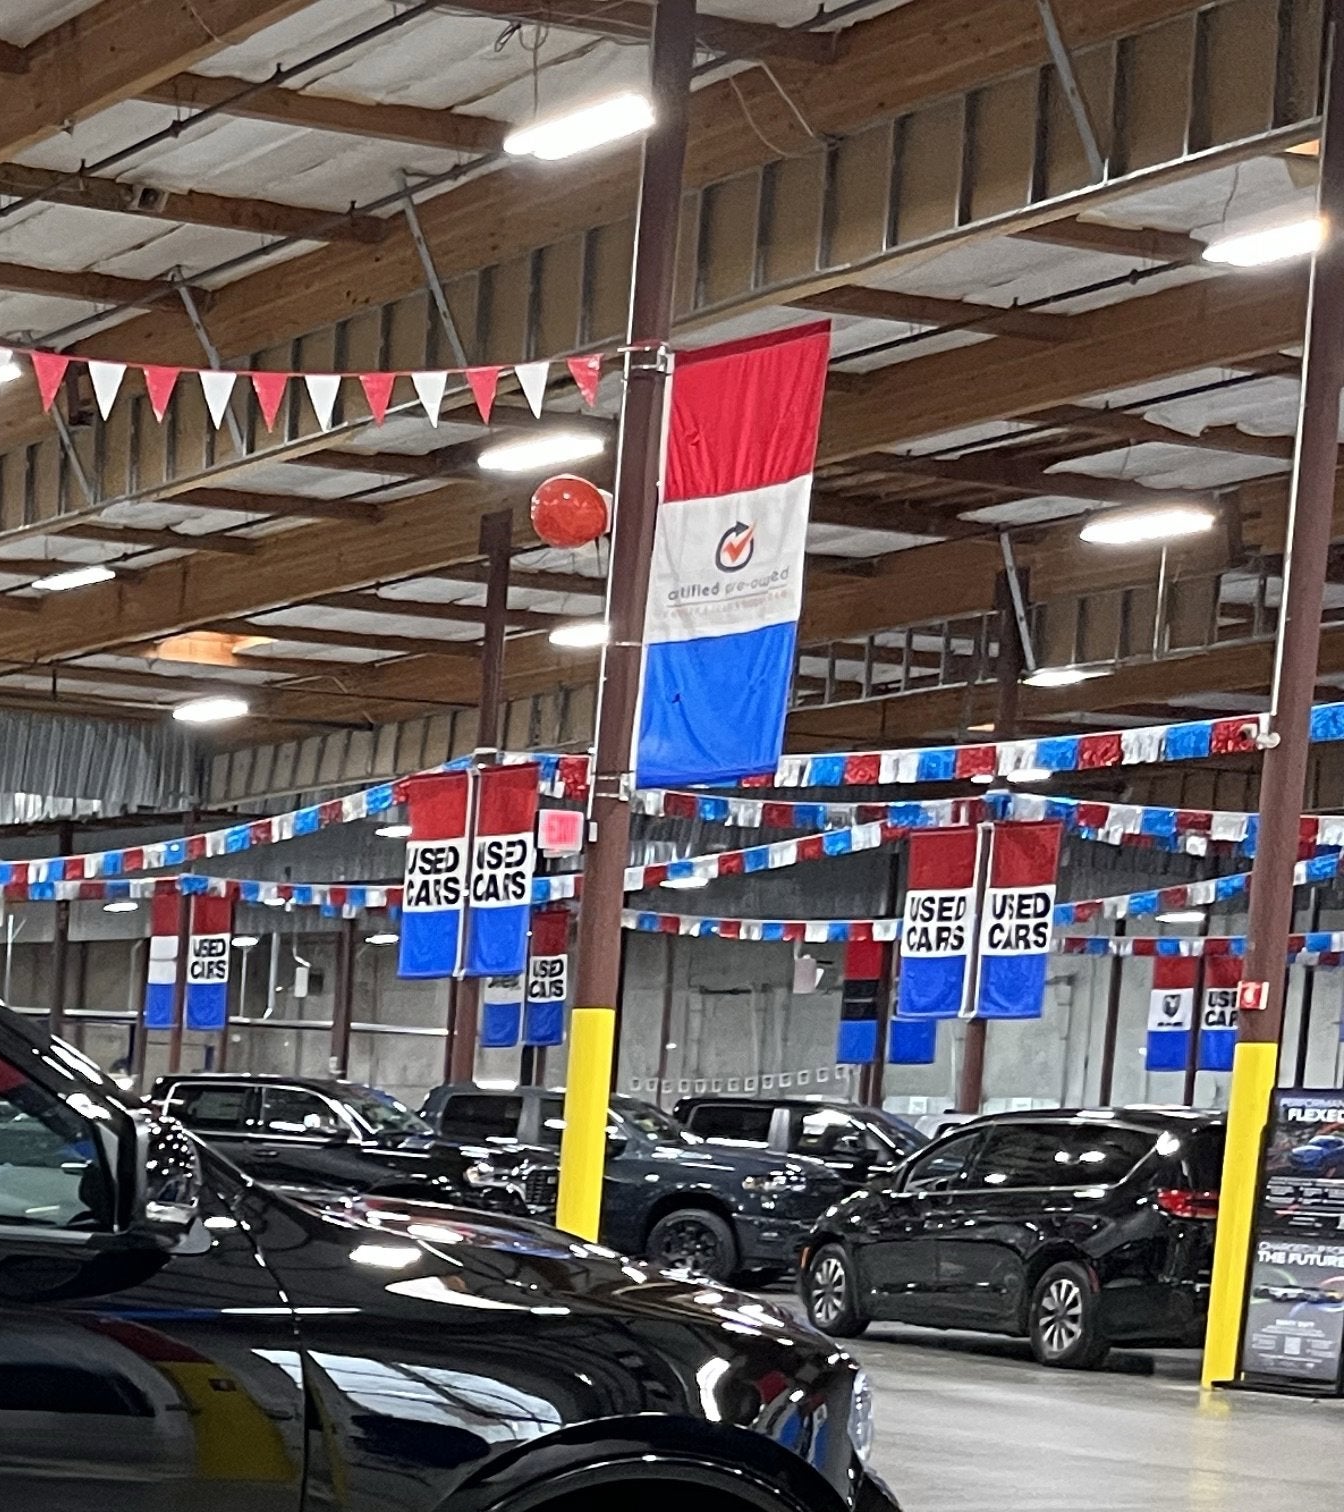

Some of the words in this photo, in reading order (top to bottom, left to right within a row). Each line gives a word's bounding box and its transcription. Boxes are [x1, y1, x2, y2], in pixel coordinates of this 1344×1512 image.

[407, 845, 460, 876] USED
[406, 876, 461, 906] CARS
[473, 871, 526, 901] CARS
[910, 895, 967, 923] USED
[993, 892, 1051, 921] USED
[906, 925, 965, 952] CARS
[988, 921, 1049, 950] CARS
[1257, 1250, 1286, 1265] THE
[1288, 1251, 1344, 1268] FUTURE
